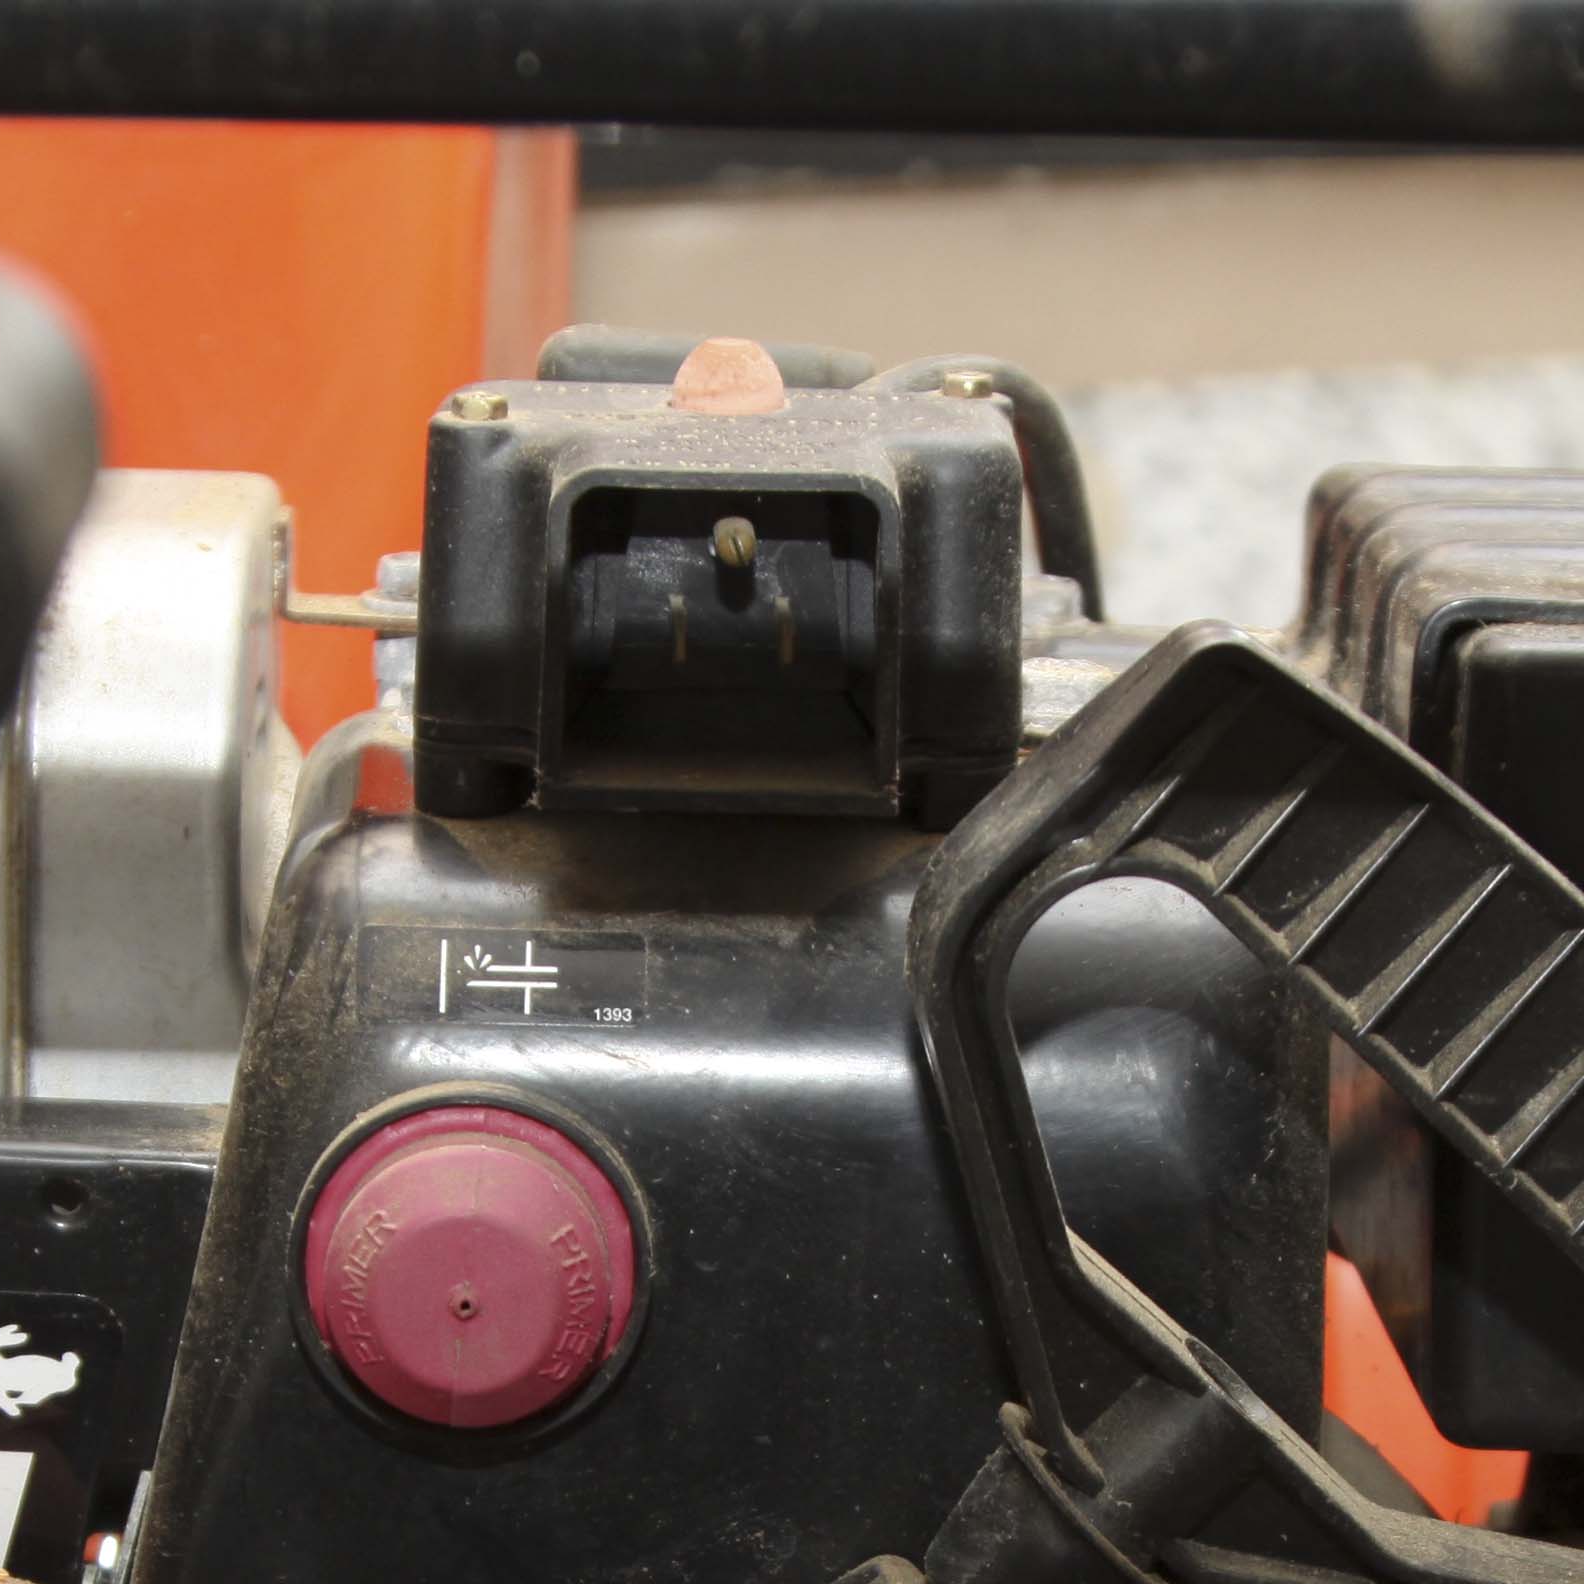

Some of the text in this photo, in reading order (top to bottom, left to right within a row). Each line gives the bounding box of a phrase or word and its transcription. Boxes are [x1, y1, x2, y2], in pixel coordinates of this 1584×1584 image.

[593, 1007, 633, 1023] 1393
[341, 1208, 398, 1366] PRIMER
[538, 1223, 600, 1383] PRIMER
